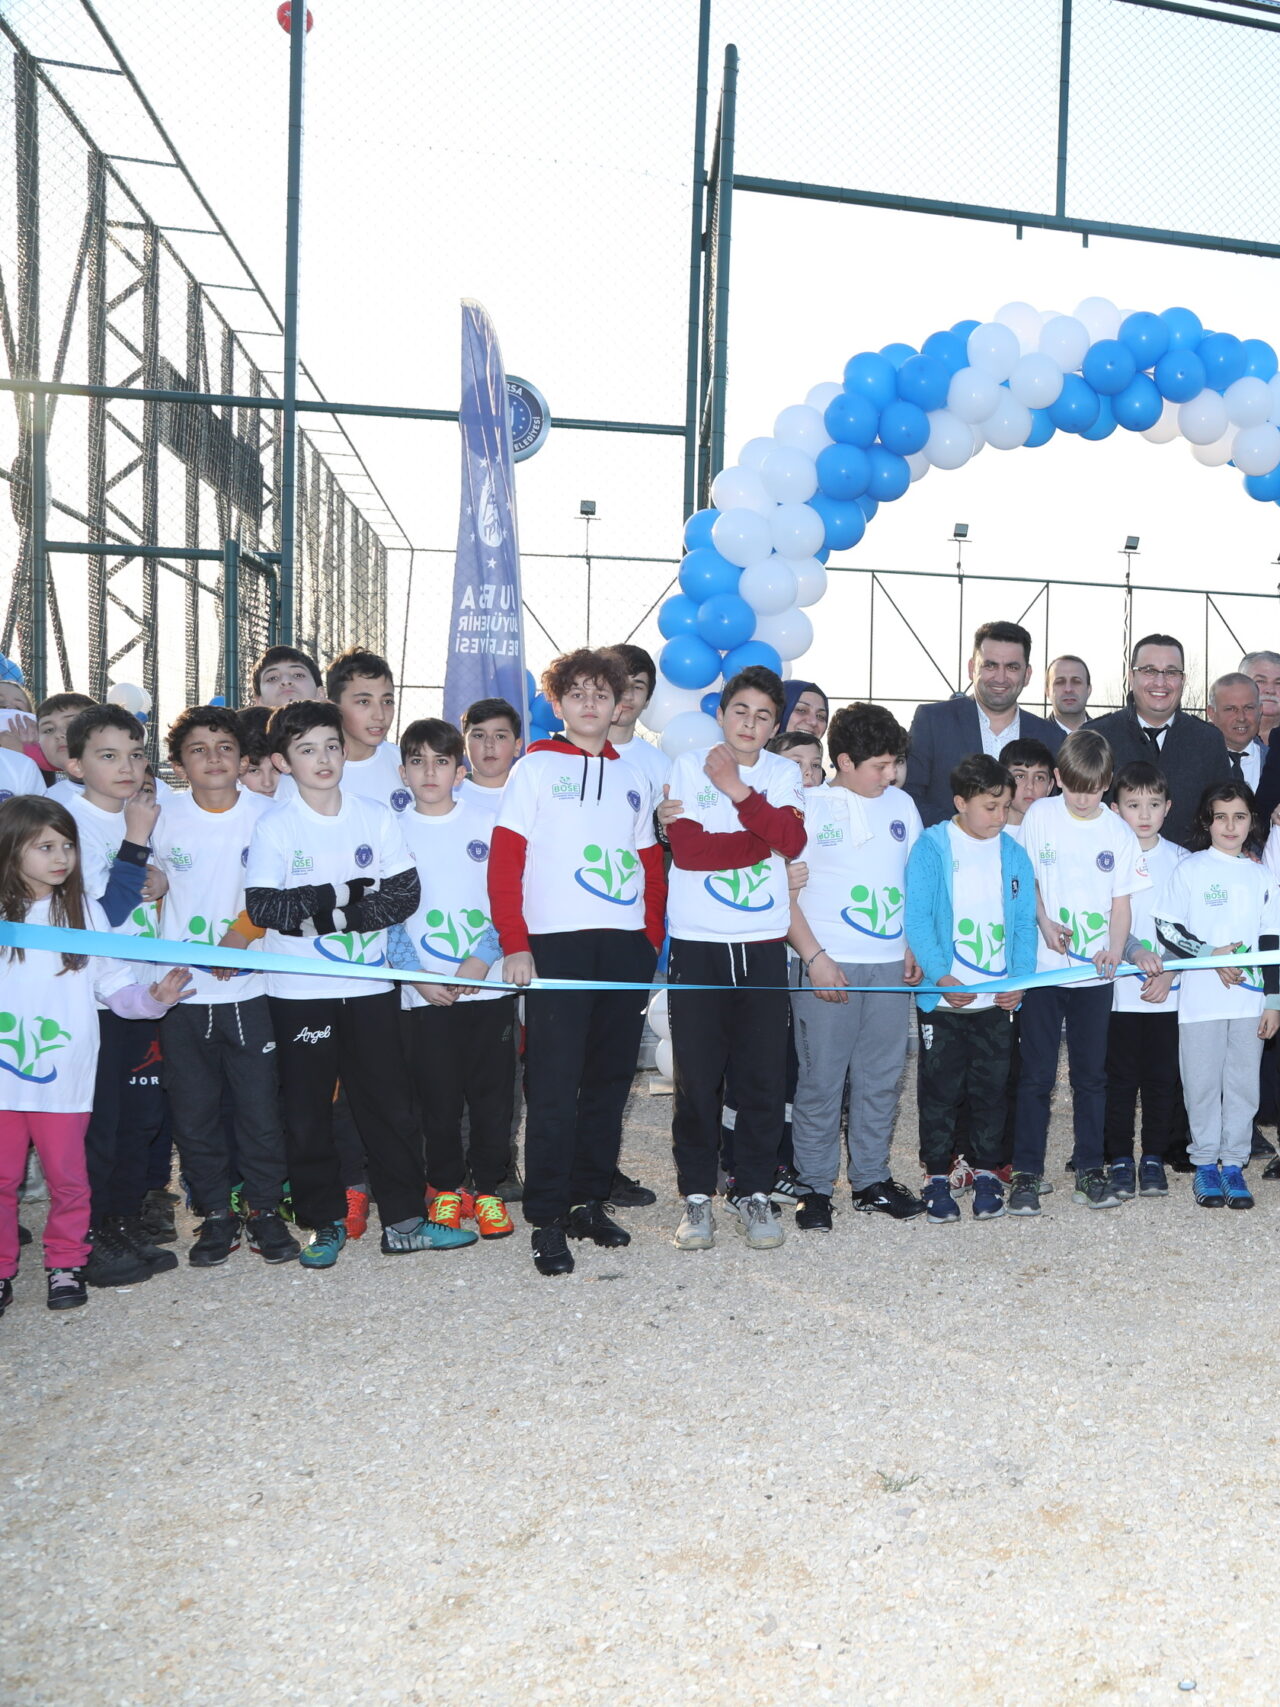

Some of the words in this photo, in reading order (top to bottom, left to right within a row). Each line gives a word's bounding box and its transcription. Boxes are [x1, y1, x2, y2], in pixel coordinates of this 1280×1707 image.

[513, 416, 542, 452] ELEDİYESİ
[294, 859, 311, 868] OSE
[129, 1076, 160, 1085] JOR
